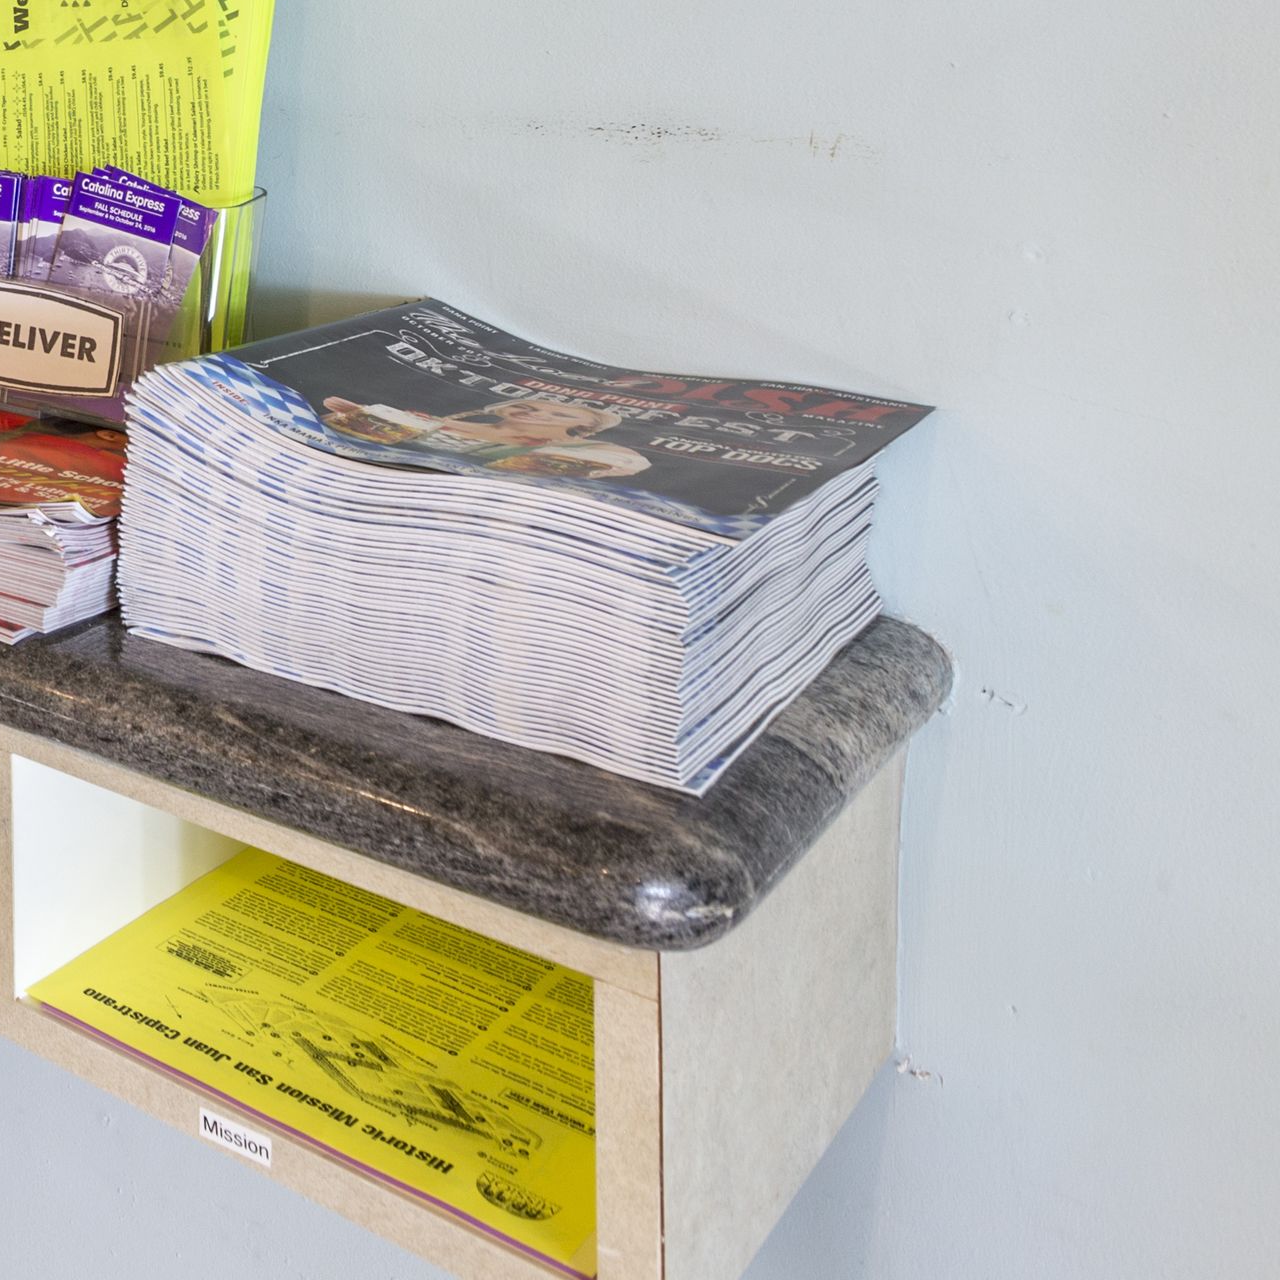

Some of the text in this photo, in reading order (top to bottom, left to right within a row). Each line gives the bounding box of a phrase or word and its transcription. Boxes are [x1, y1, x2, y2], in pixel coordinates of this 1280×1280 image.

[82, 179, 165, 212] Catalina Express
[79, 206, 104, 218] September
[115, 216, 134, 226] October
[144, 224, 155, 233] 2016
[95, 202, 143, 221] FALL SCHEDULE
[442, 305, 498, 335] DANA POINT
[523, 379, 677, 410] DANA POINT
[802, 414, 884, 430] MAGAZINE
[648, 436, 823, 471] TOP DOGS
[82, 986, 453, 1175] Historic Mission San Juan Capistrano
[202, 1114, 270, 1161] Mission
